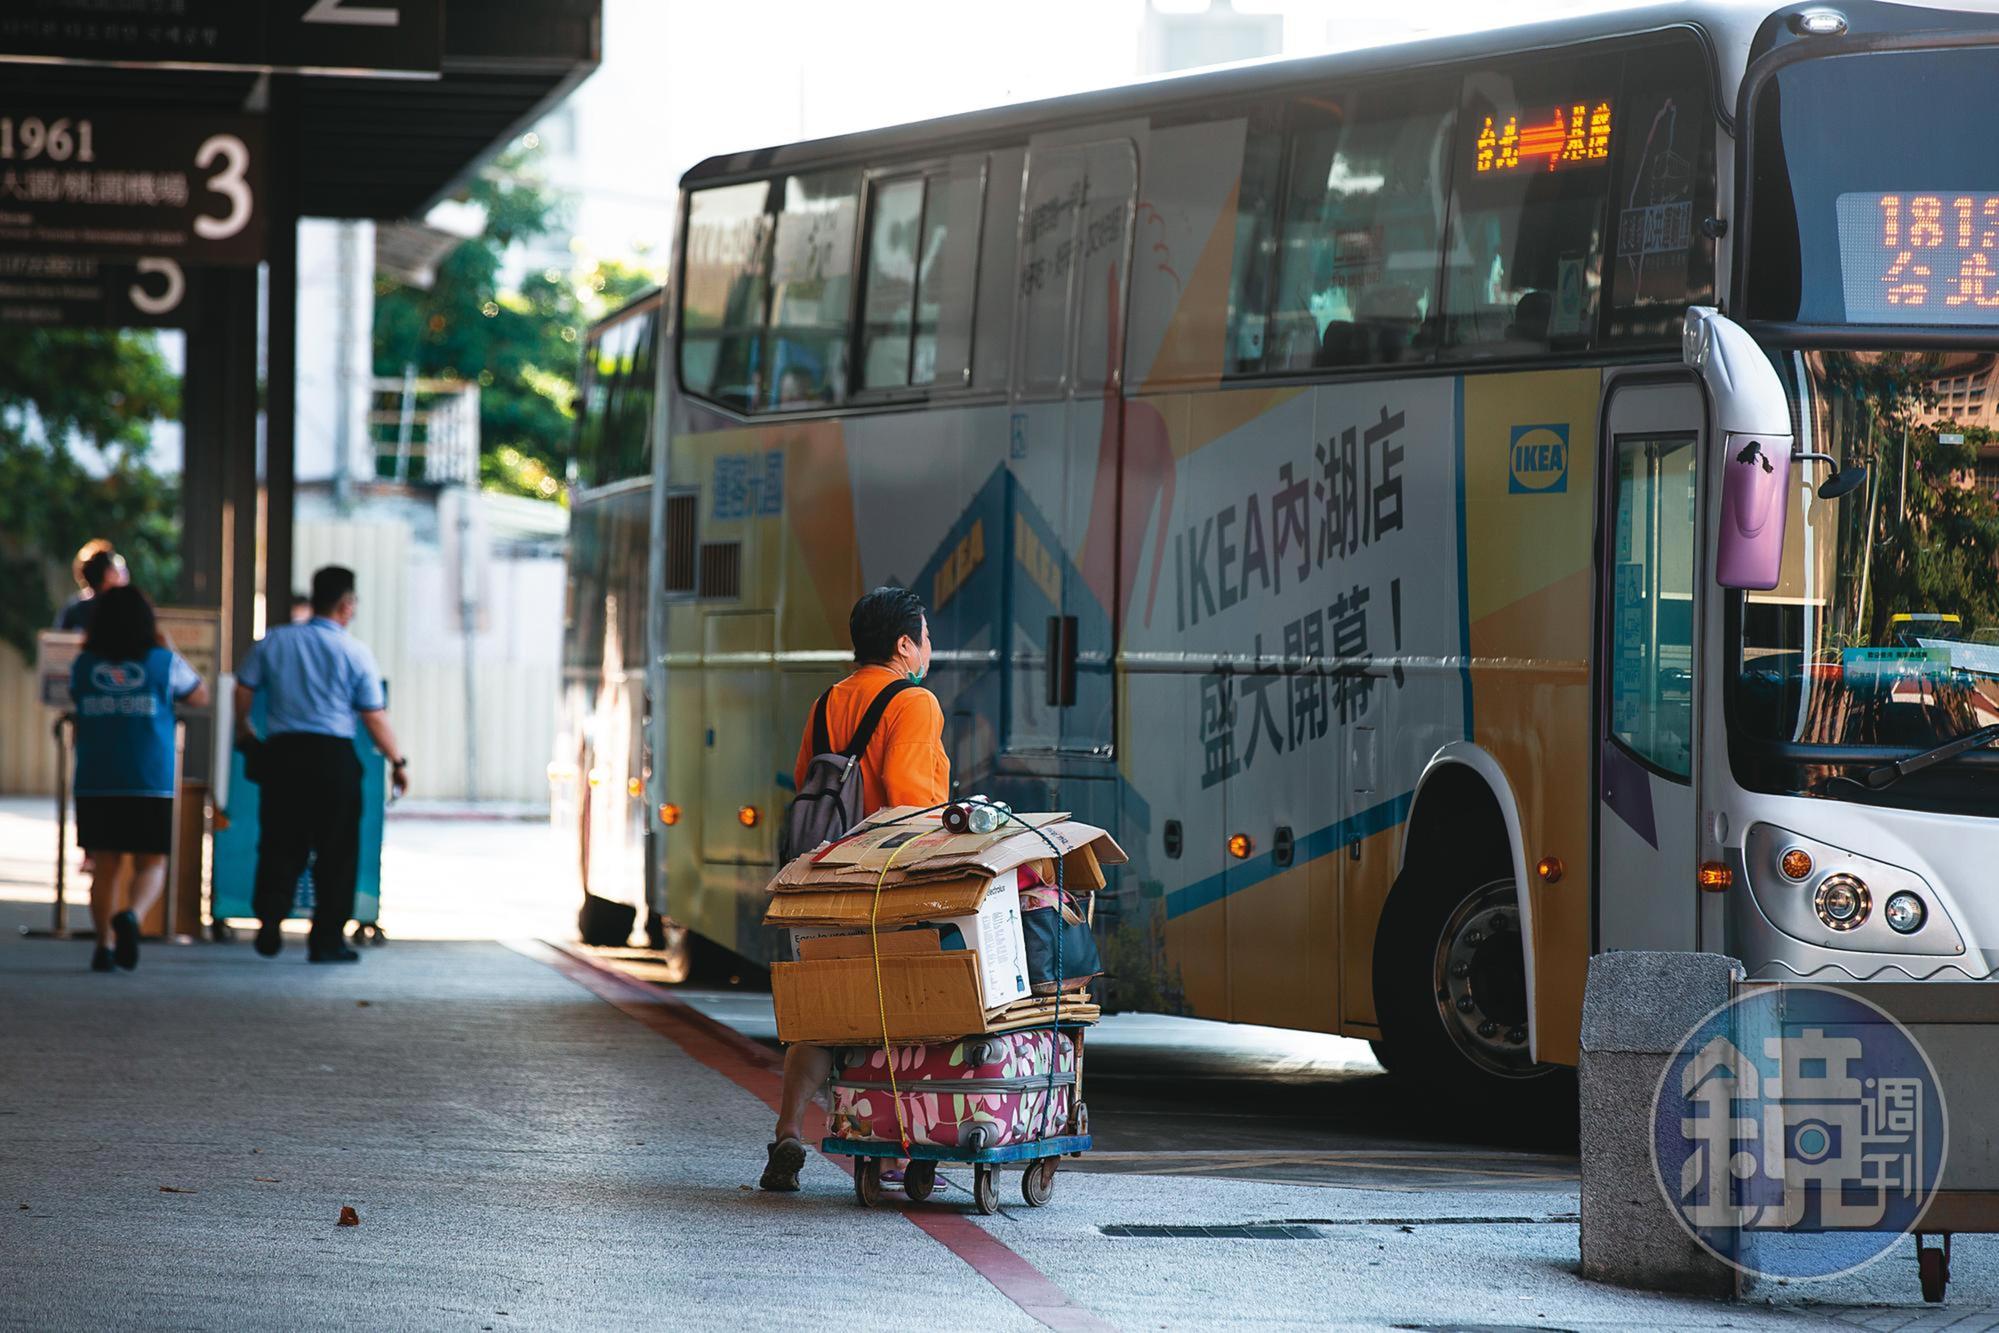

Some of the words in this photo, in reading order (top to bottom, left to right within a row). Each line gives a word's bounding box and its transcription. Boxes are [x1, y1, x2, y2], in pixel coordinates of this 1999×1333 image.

[0, 116, 94, 162] 1961
[194, 133, 253, 240] 3
[1516, 445, 1563, 472] IKEA
